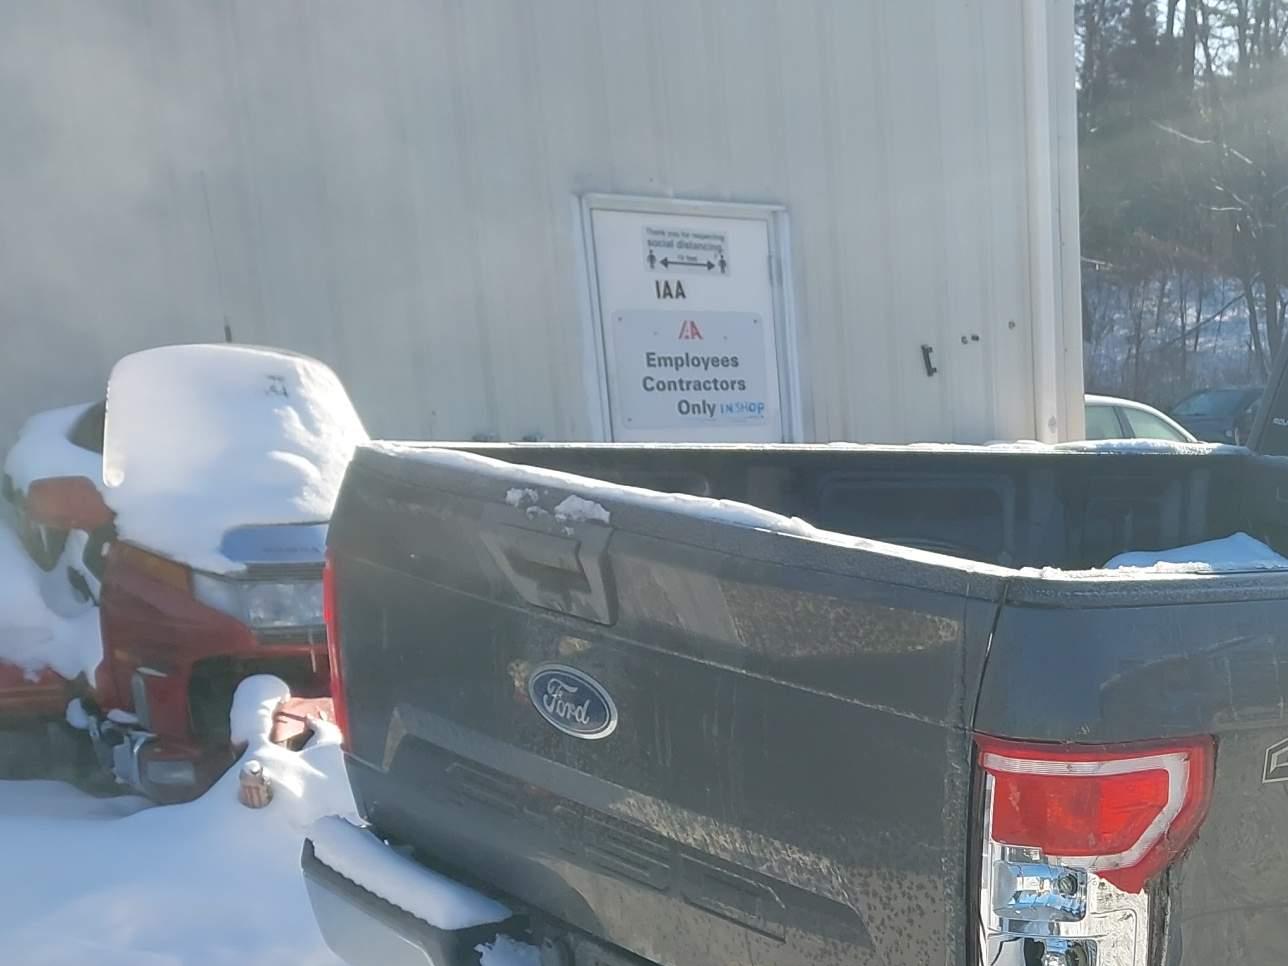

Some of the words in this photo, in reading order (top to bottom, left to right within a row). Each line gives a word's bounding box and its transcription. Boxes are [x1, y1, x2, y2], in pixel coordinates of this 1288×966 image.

[647, 239, 674, 248] social
[676, 241, 723, 252] distancing
[655, 280, 686, 299] IAA
[646, 352, 740, 371] Employees
[642, 376, 746, 393] Contractors
[677, 399, 716, 418] Only
[542, 678, 590, 724] Ford
